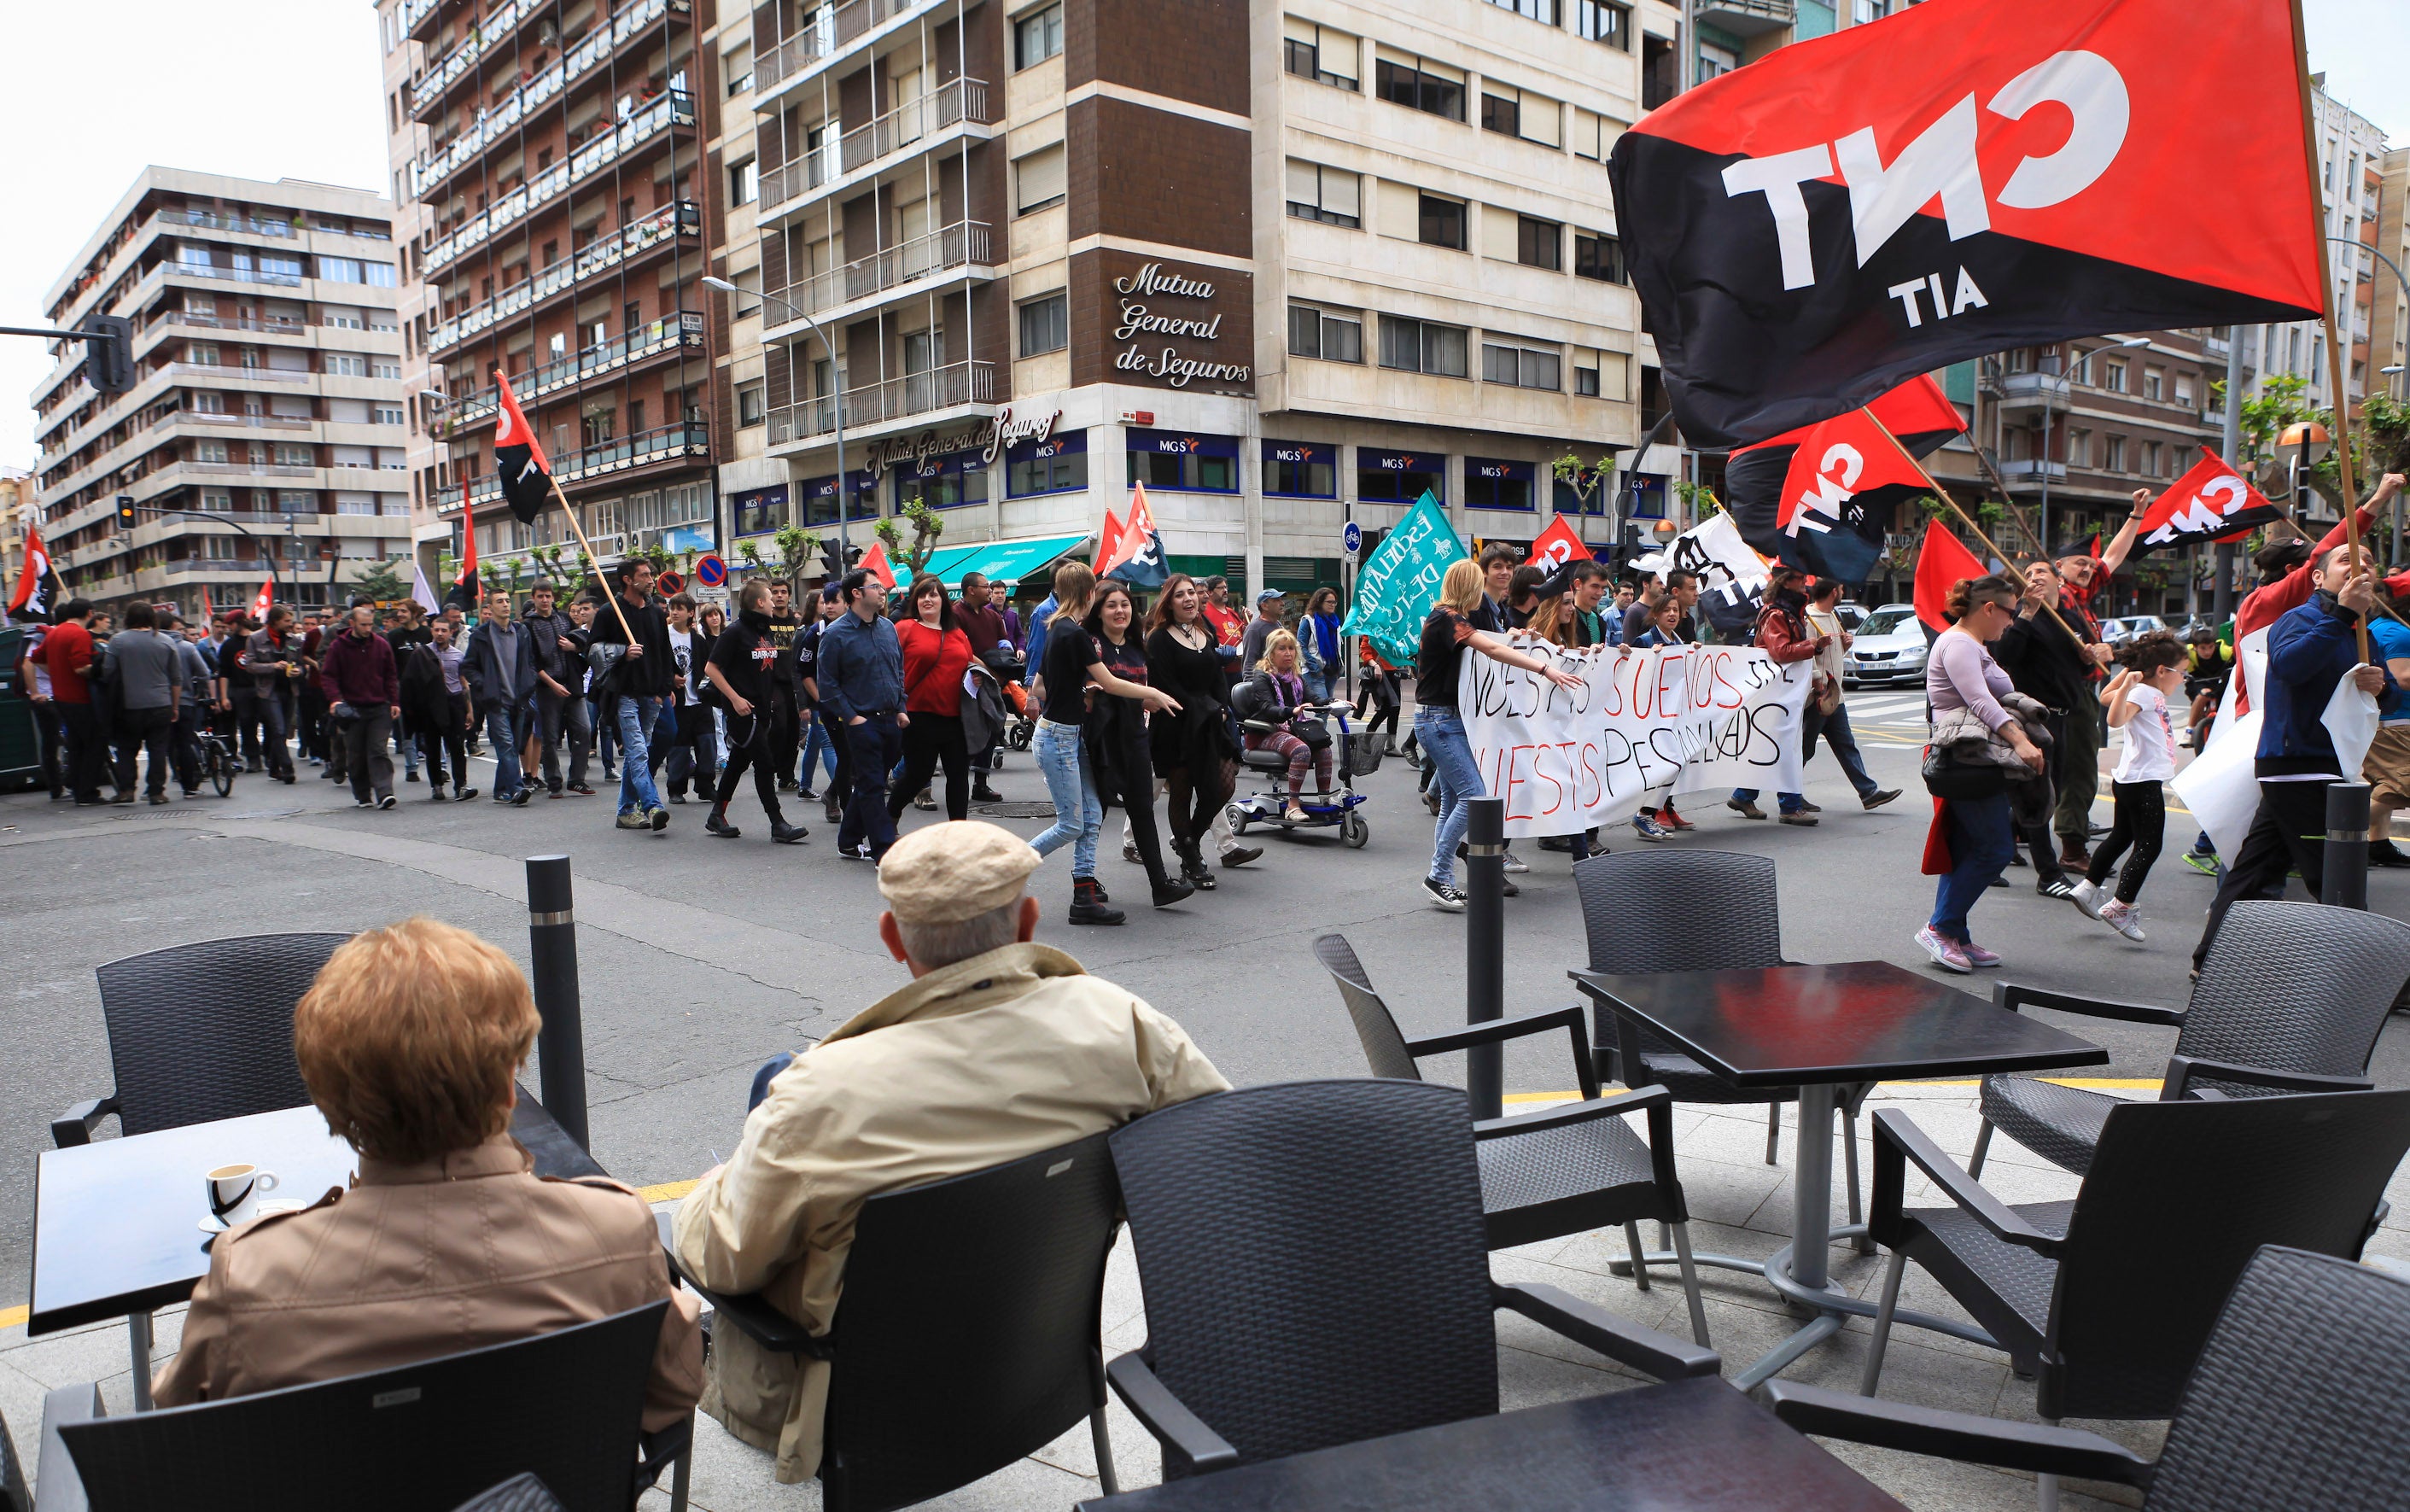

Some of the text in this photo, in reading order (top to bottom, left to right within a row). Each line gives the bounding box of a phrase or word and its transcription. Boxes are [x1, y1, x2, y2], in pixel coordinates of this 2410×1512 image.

[1115, 262, 1216, 299] Mutua
[1114, 298, 1223, 340] General
[1116, 344, 1251, 388] de Seguros
[916, 429, 975, 475] General
[983, 407, 1061, 464] Seguros
[1160, 440, 1187, 452] MGS
[1276, 449, 1301, 462] MGS
[1381, 458, 1404, 470] MGS
[1481, 466, 1502, 477] MGS
[1631, 479, 1643, 489] GS
